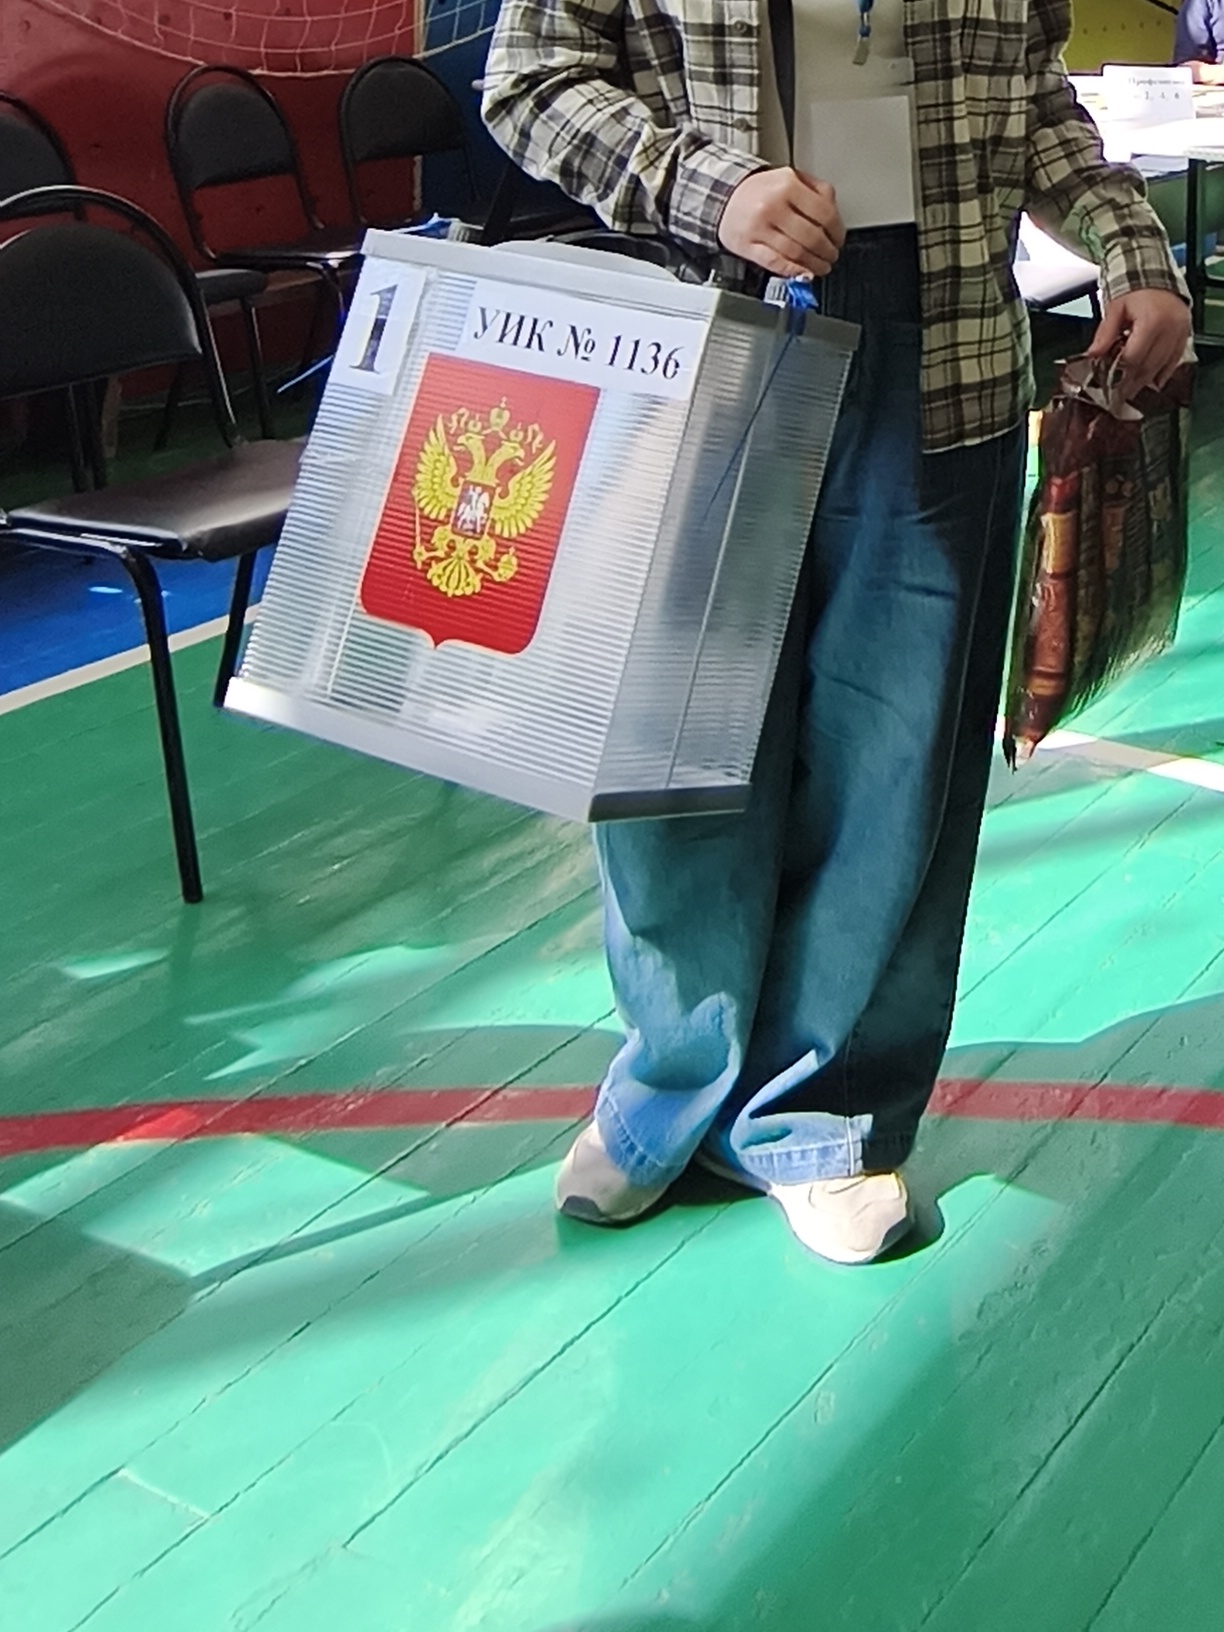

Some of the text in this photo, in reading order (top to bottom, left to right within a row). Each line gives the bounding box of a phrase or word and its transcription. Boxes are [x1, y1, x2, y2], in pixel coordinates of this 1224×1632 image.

[349, 284, 398, 374] 1
[474, 306, 686, 380] УИК № 1136
